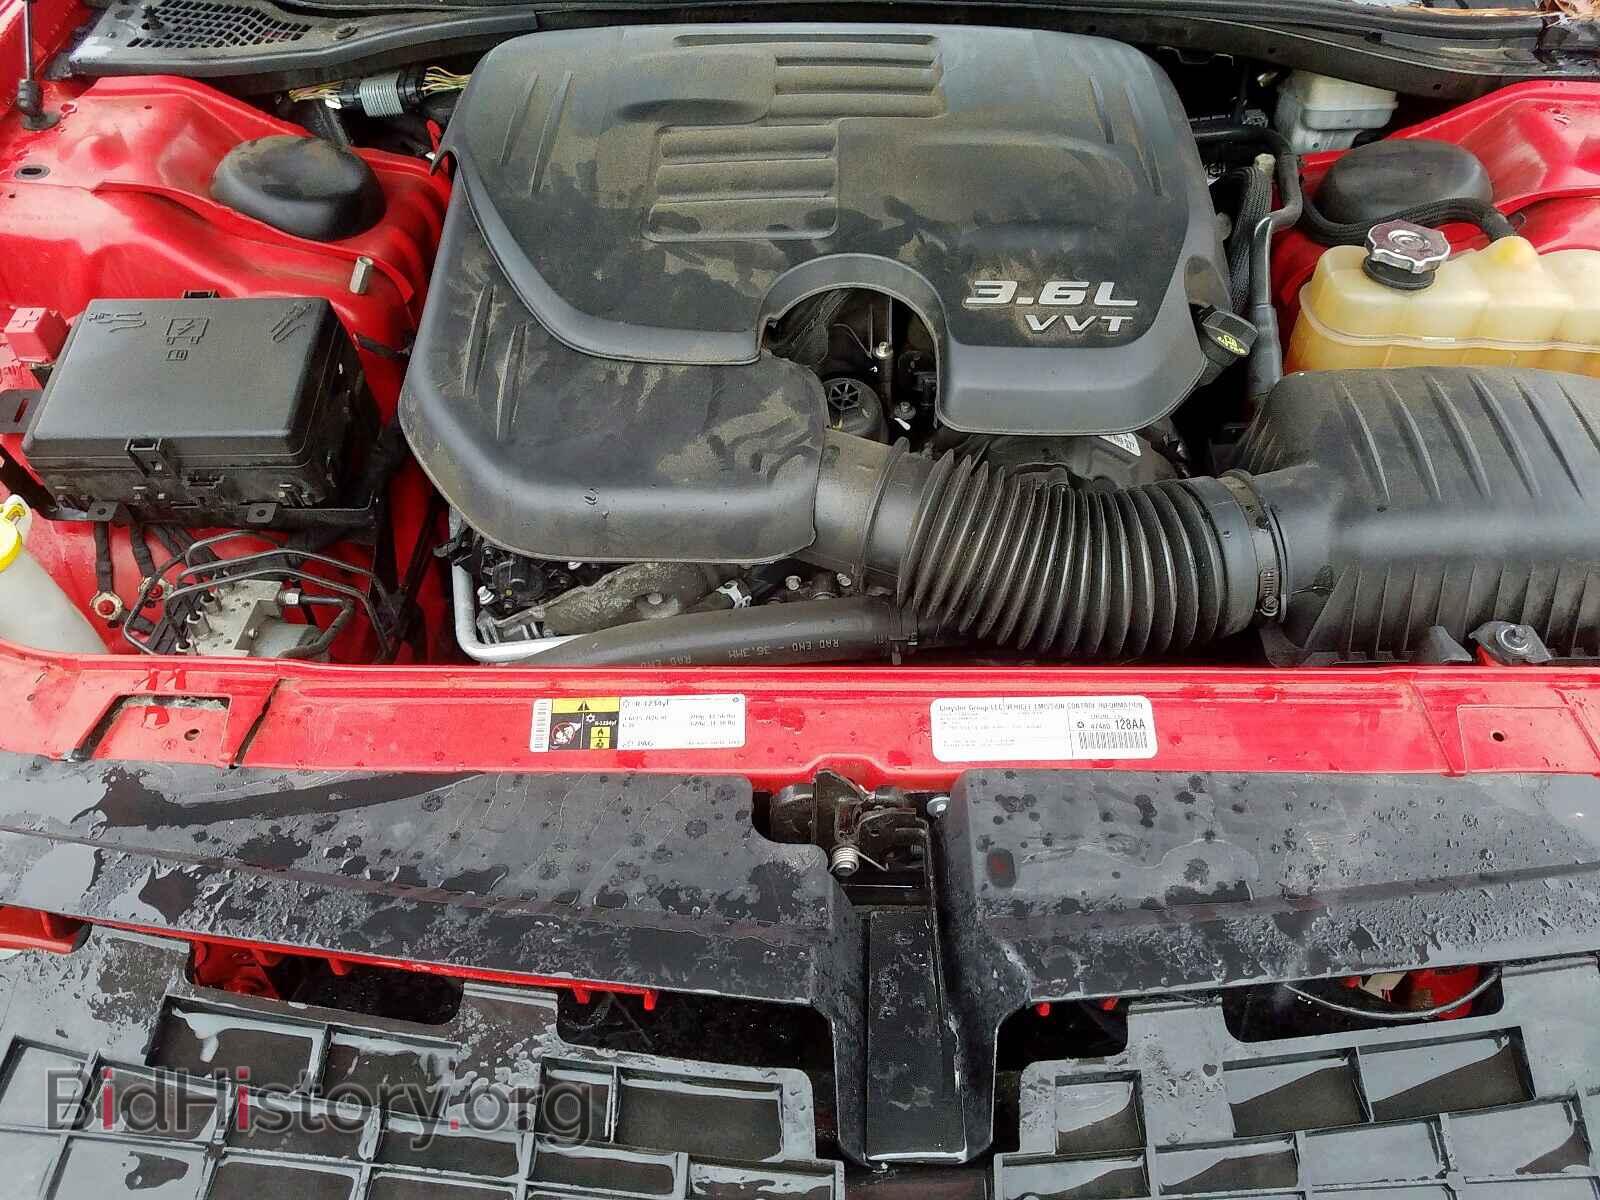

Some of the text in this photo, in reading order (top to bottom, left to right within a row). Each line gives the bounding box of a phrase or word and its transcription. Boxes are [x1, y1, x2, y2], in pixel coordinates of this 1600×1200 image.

[964, 281, 1138, 306] 3.6L
[1024, 314, 1134, 333] VVT
[819, 638, 840, 650] RAD
[1114, 718, 1146, 730] 128AA
